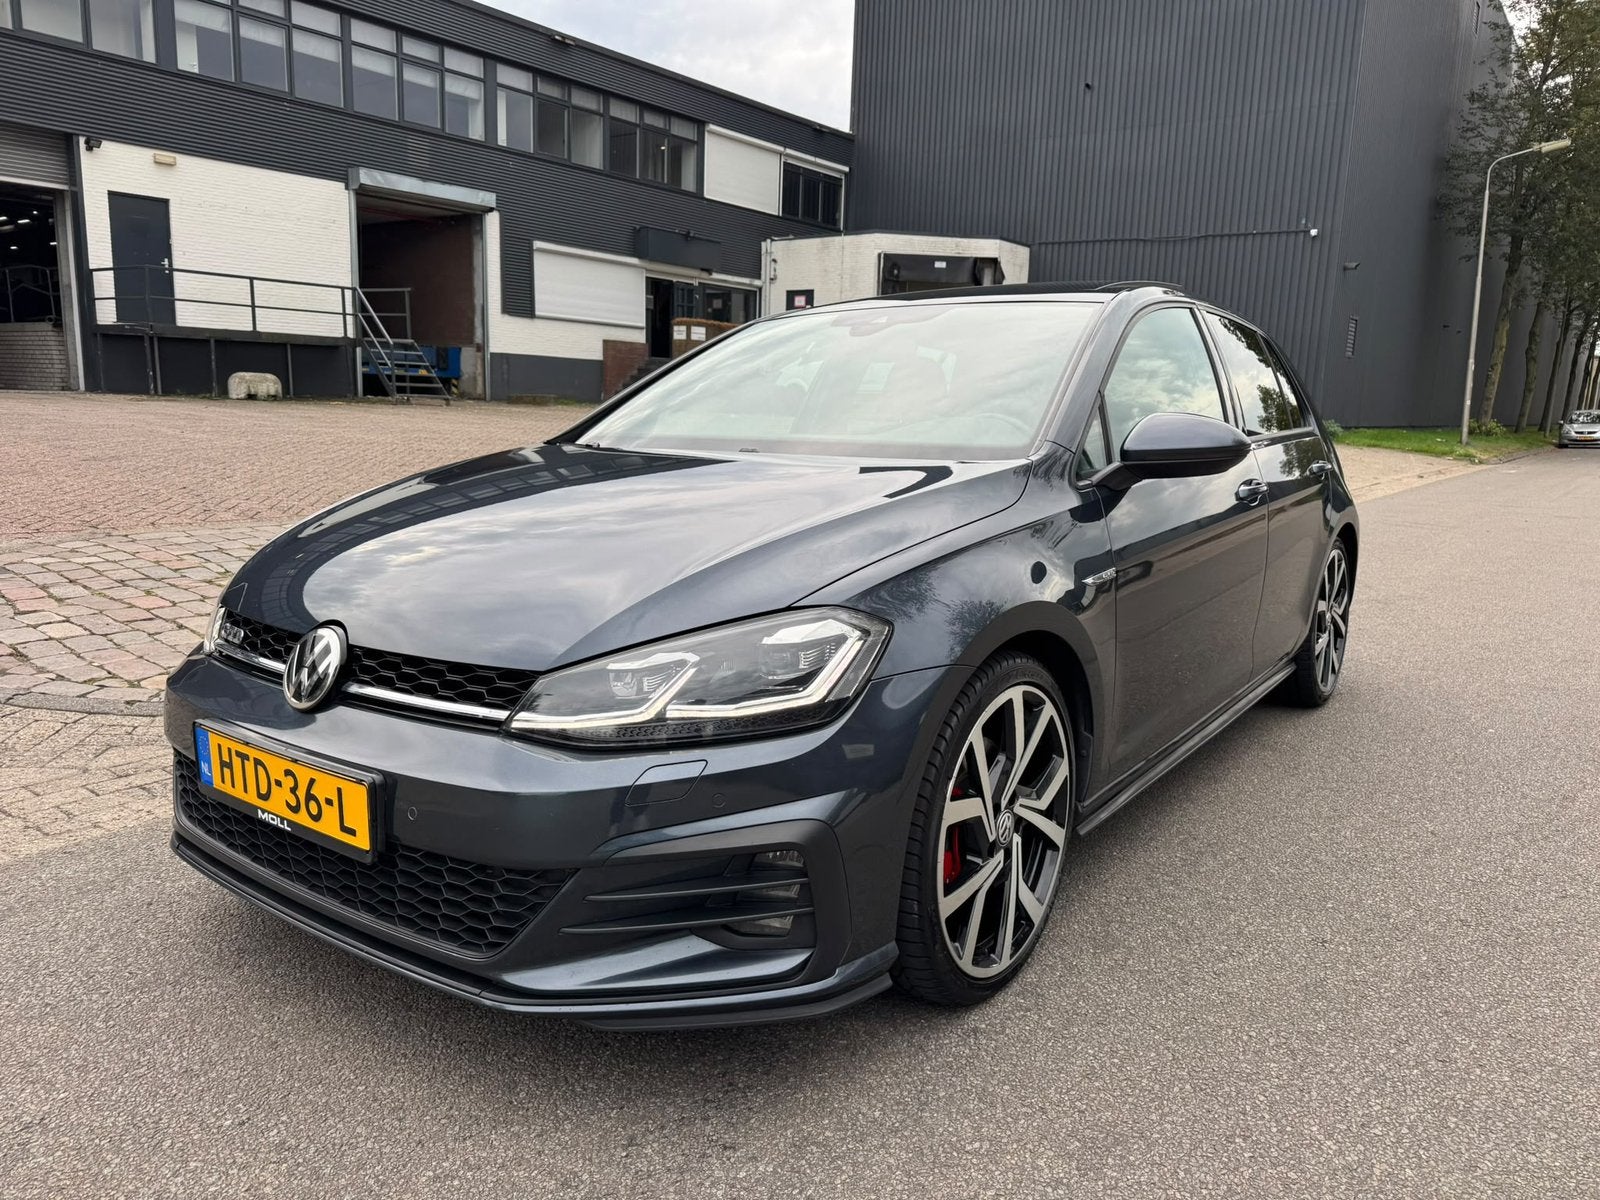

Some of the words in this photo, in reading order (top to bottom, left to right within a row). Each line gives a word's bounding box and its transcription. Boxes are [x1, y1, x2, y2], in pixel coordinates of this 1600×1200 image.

[201, 760, 212, 776] NL
[216, 742, 358, 838] HTD-36-L
[257, 808, 292, 832] MOLL
